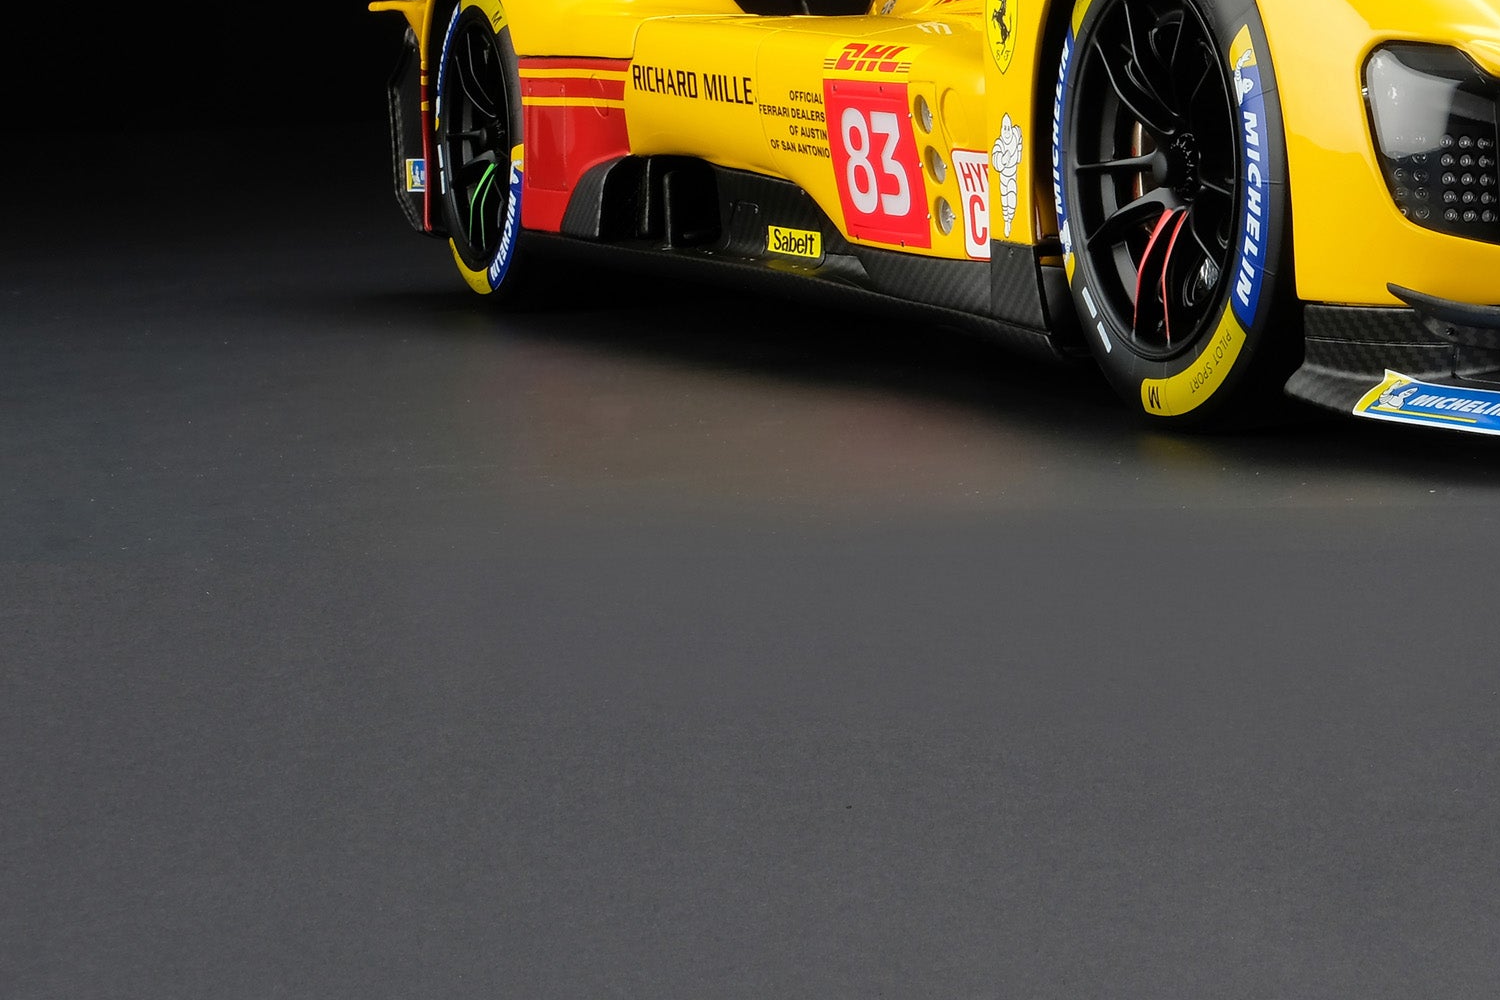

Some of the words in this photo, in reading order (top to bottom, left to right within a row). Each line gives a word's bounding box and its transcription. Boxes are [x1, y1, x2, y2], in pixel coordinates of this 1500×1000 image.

[834, 43, 911, 73] DHL
[632, 65, 697, 99] RICHARD
[703, 72, 753, 105] MILLE
[789, 90, 823, 104] OFFICIAL
[759, 104, 790, 117] FERRARI
[791, 108, 826, 122] DEALERS
[789, 125, 798, 135] OF
[801, 127, 828, 140] AUSTIN
[771, 139, 780, 149] OF
[781, 140, 797, 152] SAN
[798, 145, 830, 158] ANTONIO
[841, 107, 911, 217] 83
[1236, 112, 1262, 307] MICHELIN
[489, 190, 516, 281] MICHELIN
[773, 228, 815, 256] Sabelt
[1213, 329, 1232, 366] PILOT
[1189, 361, 1213, 394] SPORT
[1148, 386, 1161, 409] M
